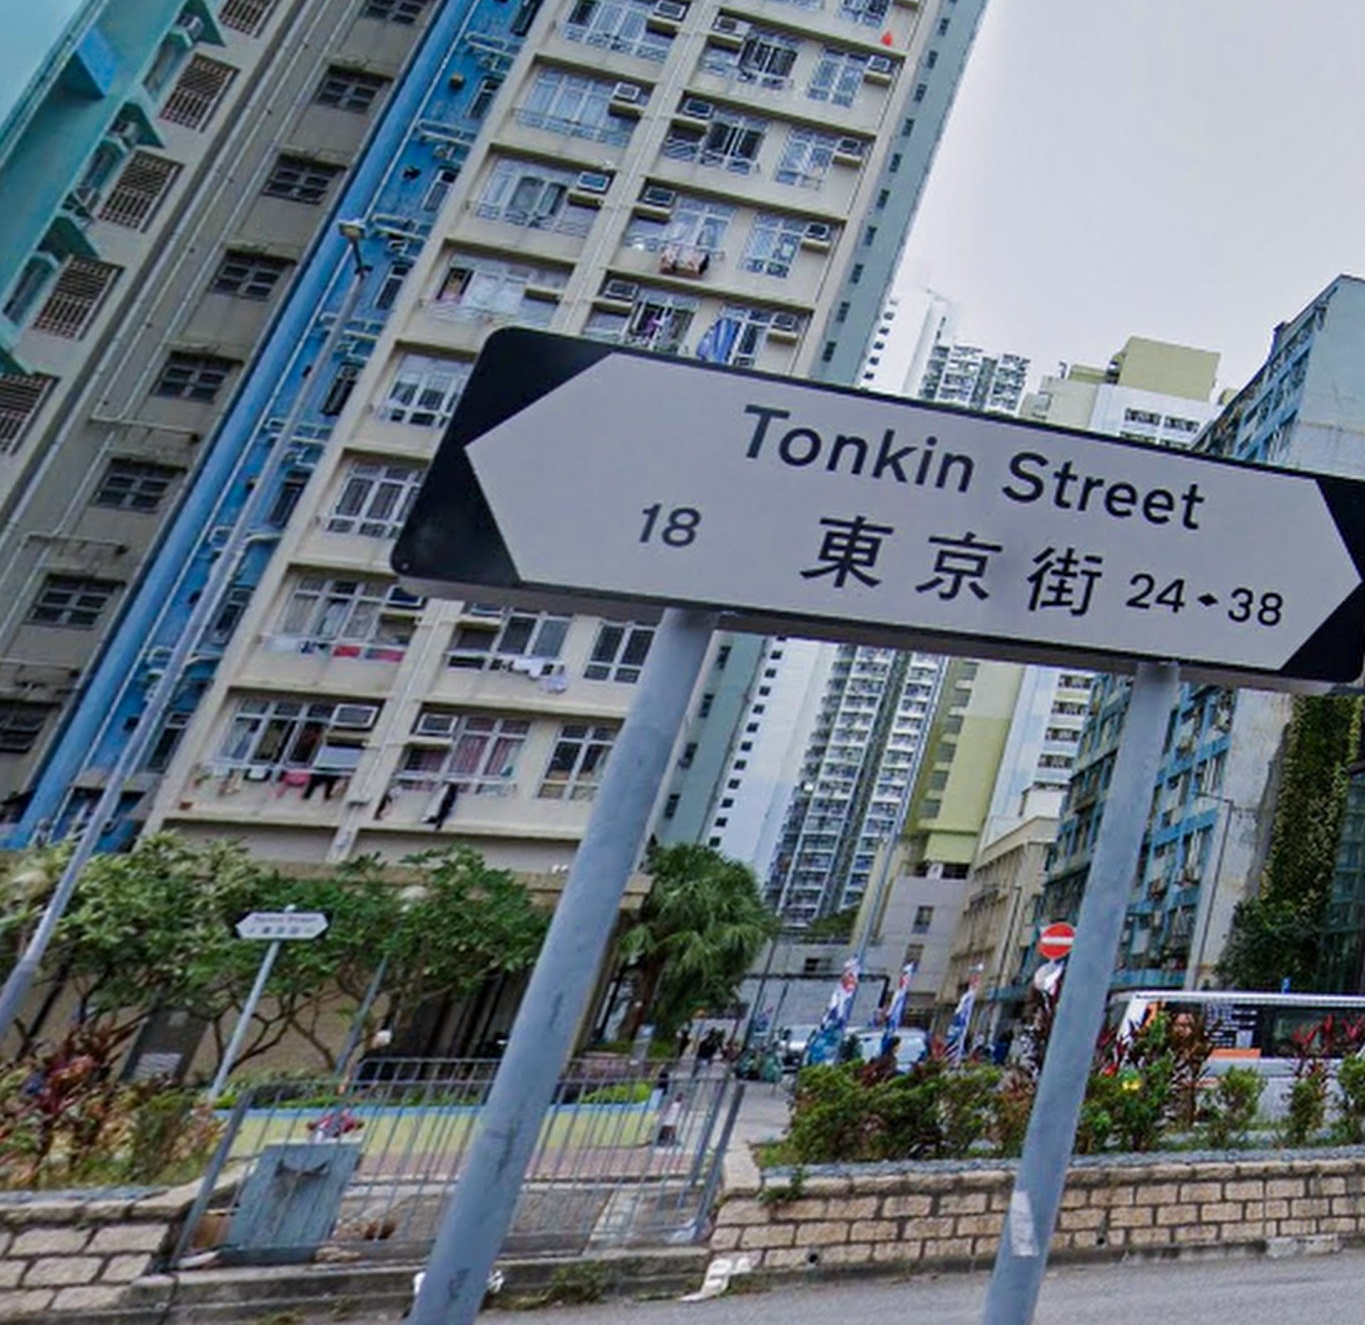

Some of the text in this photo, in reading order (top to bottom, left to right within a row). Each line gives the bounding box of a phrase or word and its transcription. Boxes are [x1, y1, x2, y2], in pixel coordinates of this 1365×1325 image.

[744, 404, 1205, 531] Tonkin Street
[639, 503, 702, 548] 18
[799, 515, 1105, 618] 東京街
